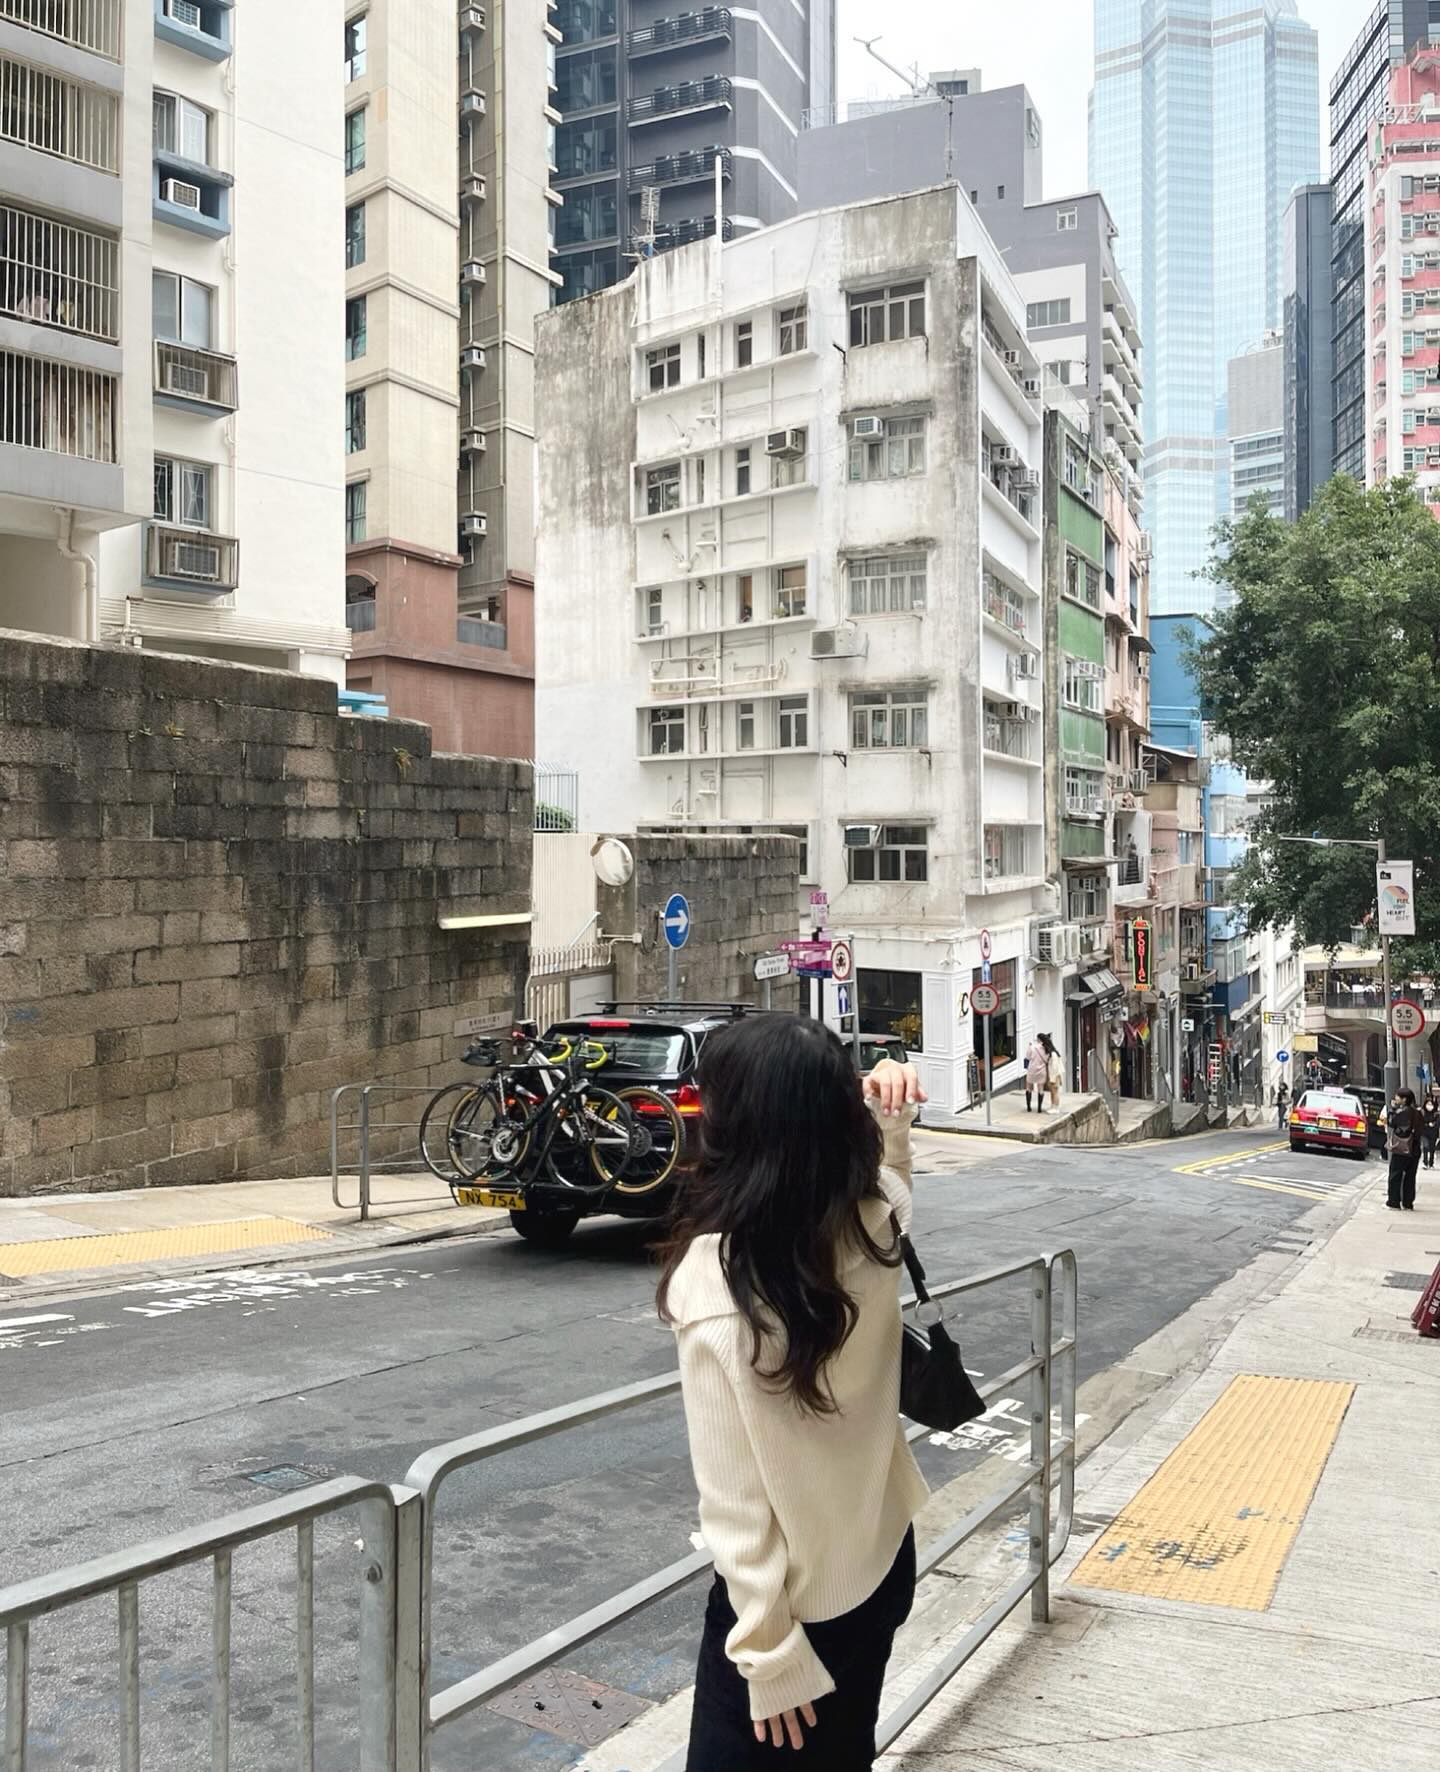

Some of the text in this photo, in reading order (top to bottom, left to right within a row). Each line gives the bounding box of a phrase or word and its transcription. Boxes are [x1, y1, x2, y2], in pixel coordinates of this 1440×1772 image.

[1137, 931, 1146, 982] PONTIAC
[977, 990, 991, 999] 5.5
[1396, 1008, 1413, 1019] 5.5
[465, 1190, 484, 1206] NX
